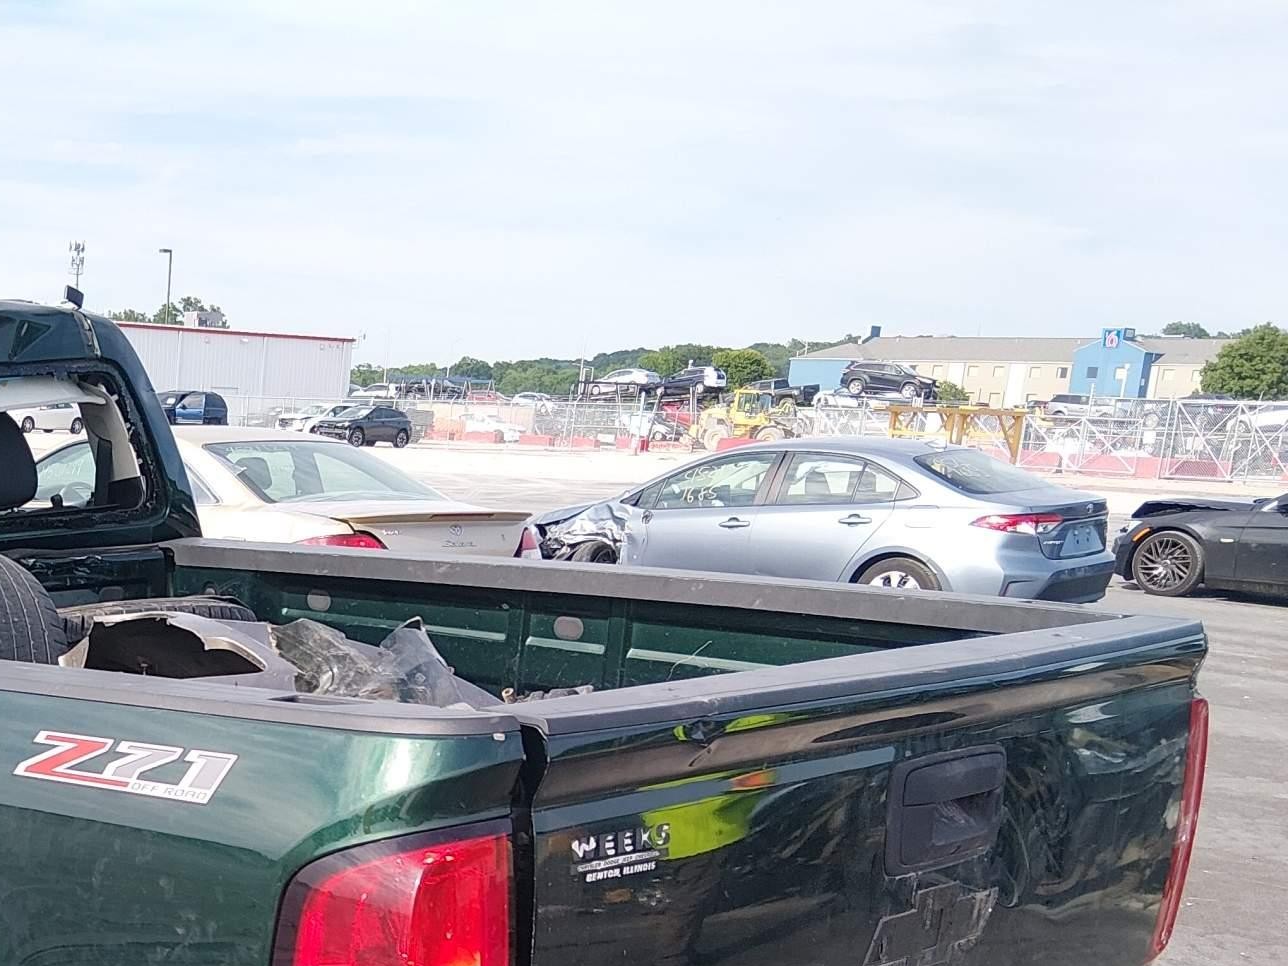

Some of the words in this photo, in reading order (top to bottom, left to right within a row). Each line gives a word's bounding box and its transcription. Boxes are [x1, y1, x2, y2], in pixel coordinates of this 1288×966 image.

[12, 730, 239, 803] Z71
[131, 782, 159, 792] OFF
[163, 787, 207, 800] ROAD
[571, 823, 671, 860] WEEKS
[623, 861, 657, 875] ILLINOIS
